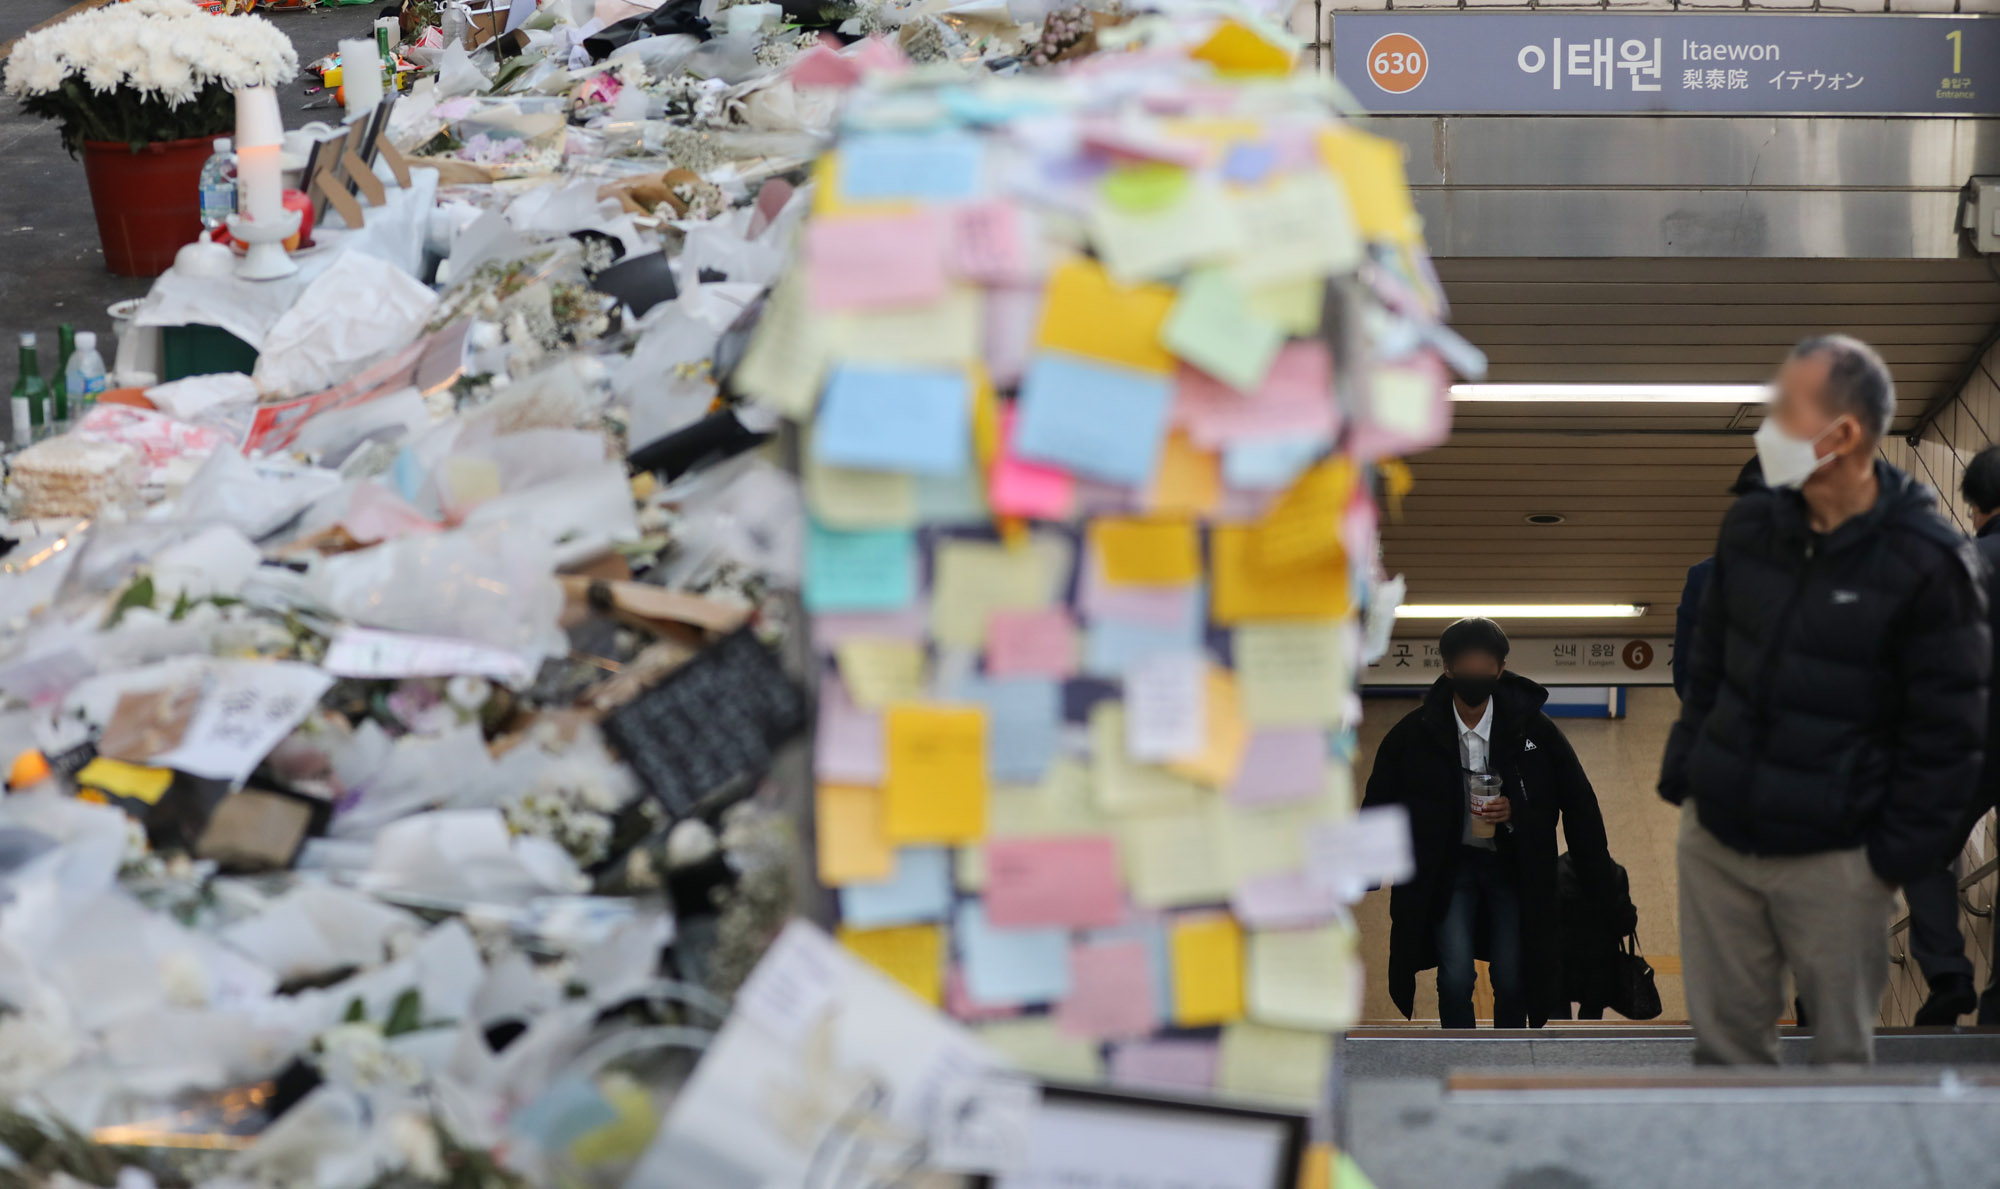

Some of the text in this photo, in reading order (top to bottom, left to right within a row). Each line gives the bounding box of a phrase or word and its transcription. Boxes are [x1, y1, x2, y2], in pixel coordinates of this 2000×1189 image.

[1682, 39, 1781, 61] Itaewon
[1945, 30, 1962, 74] 1
[1373, 52, 1422, 75] 630
[1517, 37, 1662, 92] 이태원
[1682, 68, 1864, 91] 梨泰院 イテウォン
[1936, 89, 1976, 99] Entrance
[1553, 643, 1577, 657] 신내
[1591, 643, 1615, 657] 응암
[1631, 646, 1644, 665] 6
